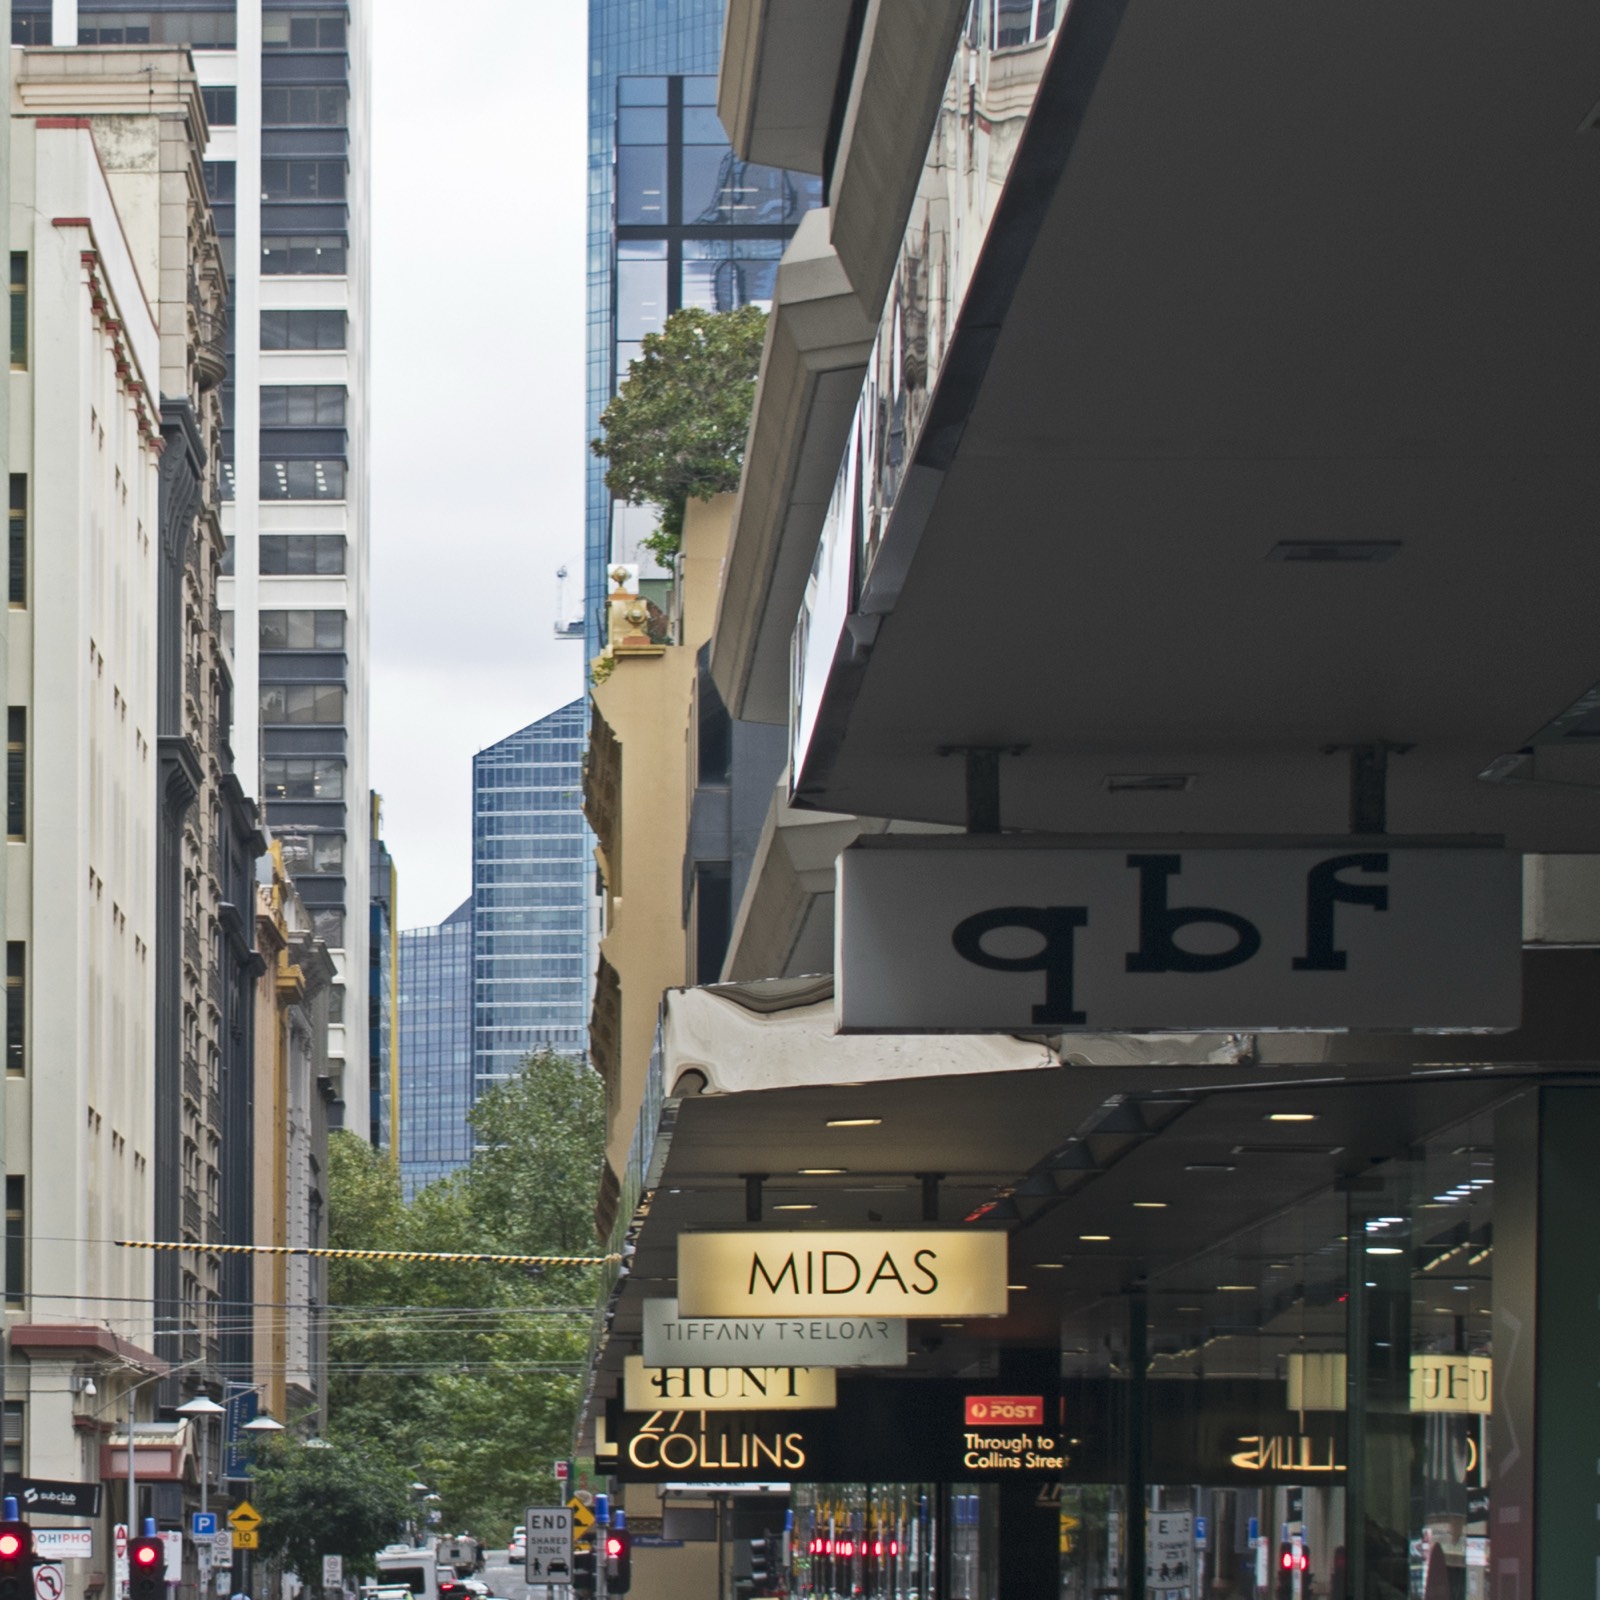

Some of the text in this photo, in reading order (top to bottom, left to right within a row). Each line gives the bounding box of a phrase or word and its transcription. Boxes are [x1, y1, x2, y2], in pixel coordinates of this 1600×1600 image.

[951, 852, 1389, 1025] qbf
[748, 1249, 939, 1295] MIDAS
[662, 1321, 890, 1341] TIFFANY TRELOAR
[651, 1367, 809, 1398] HUNT
[990, 1405, 1037, 1418] POST
[963, 1433, 1055, 1453] Through to
[628, 1433, 806, 1469] COLLINS
[964, 1452, 1021, 1468] Collins
[40, 1492, 77, 1502] subclub
[198, 1518, 211, 1531] P
[531, 1515, 567, 1529] END
[239, 1532, 251, 1542] 10
[531, 1537, 568, 1545] SHARED
[537, 1546, 562, 1554] ZONE
